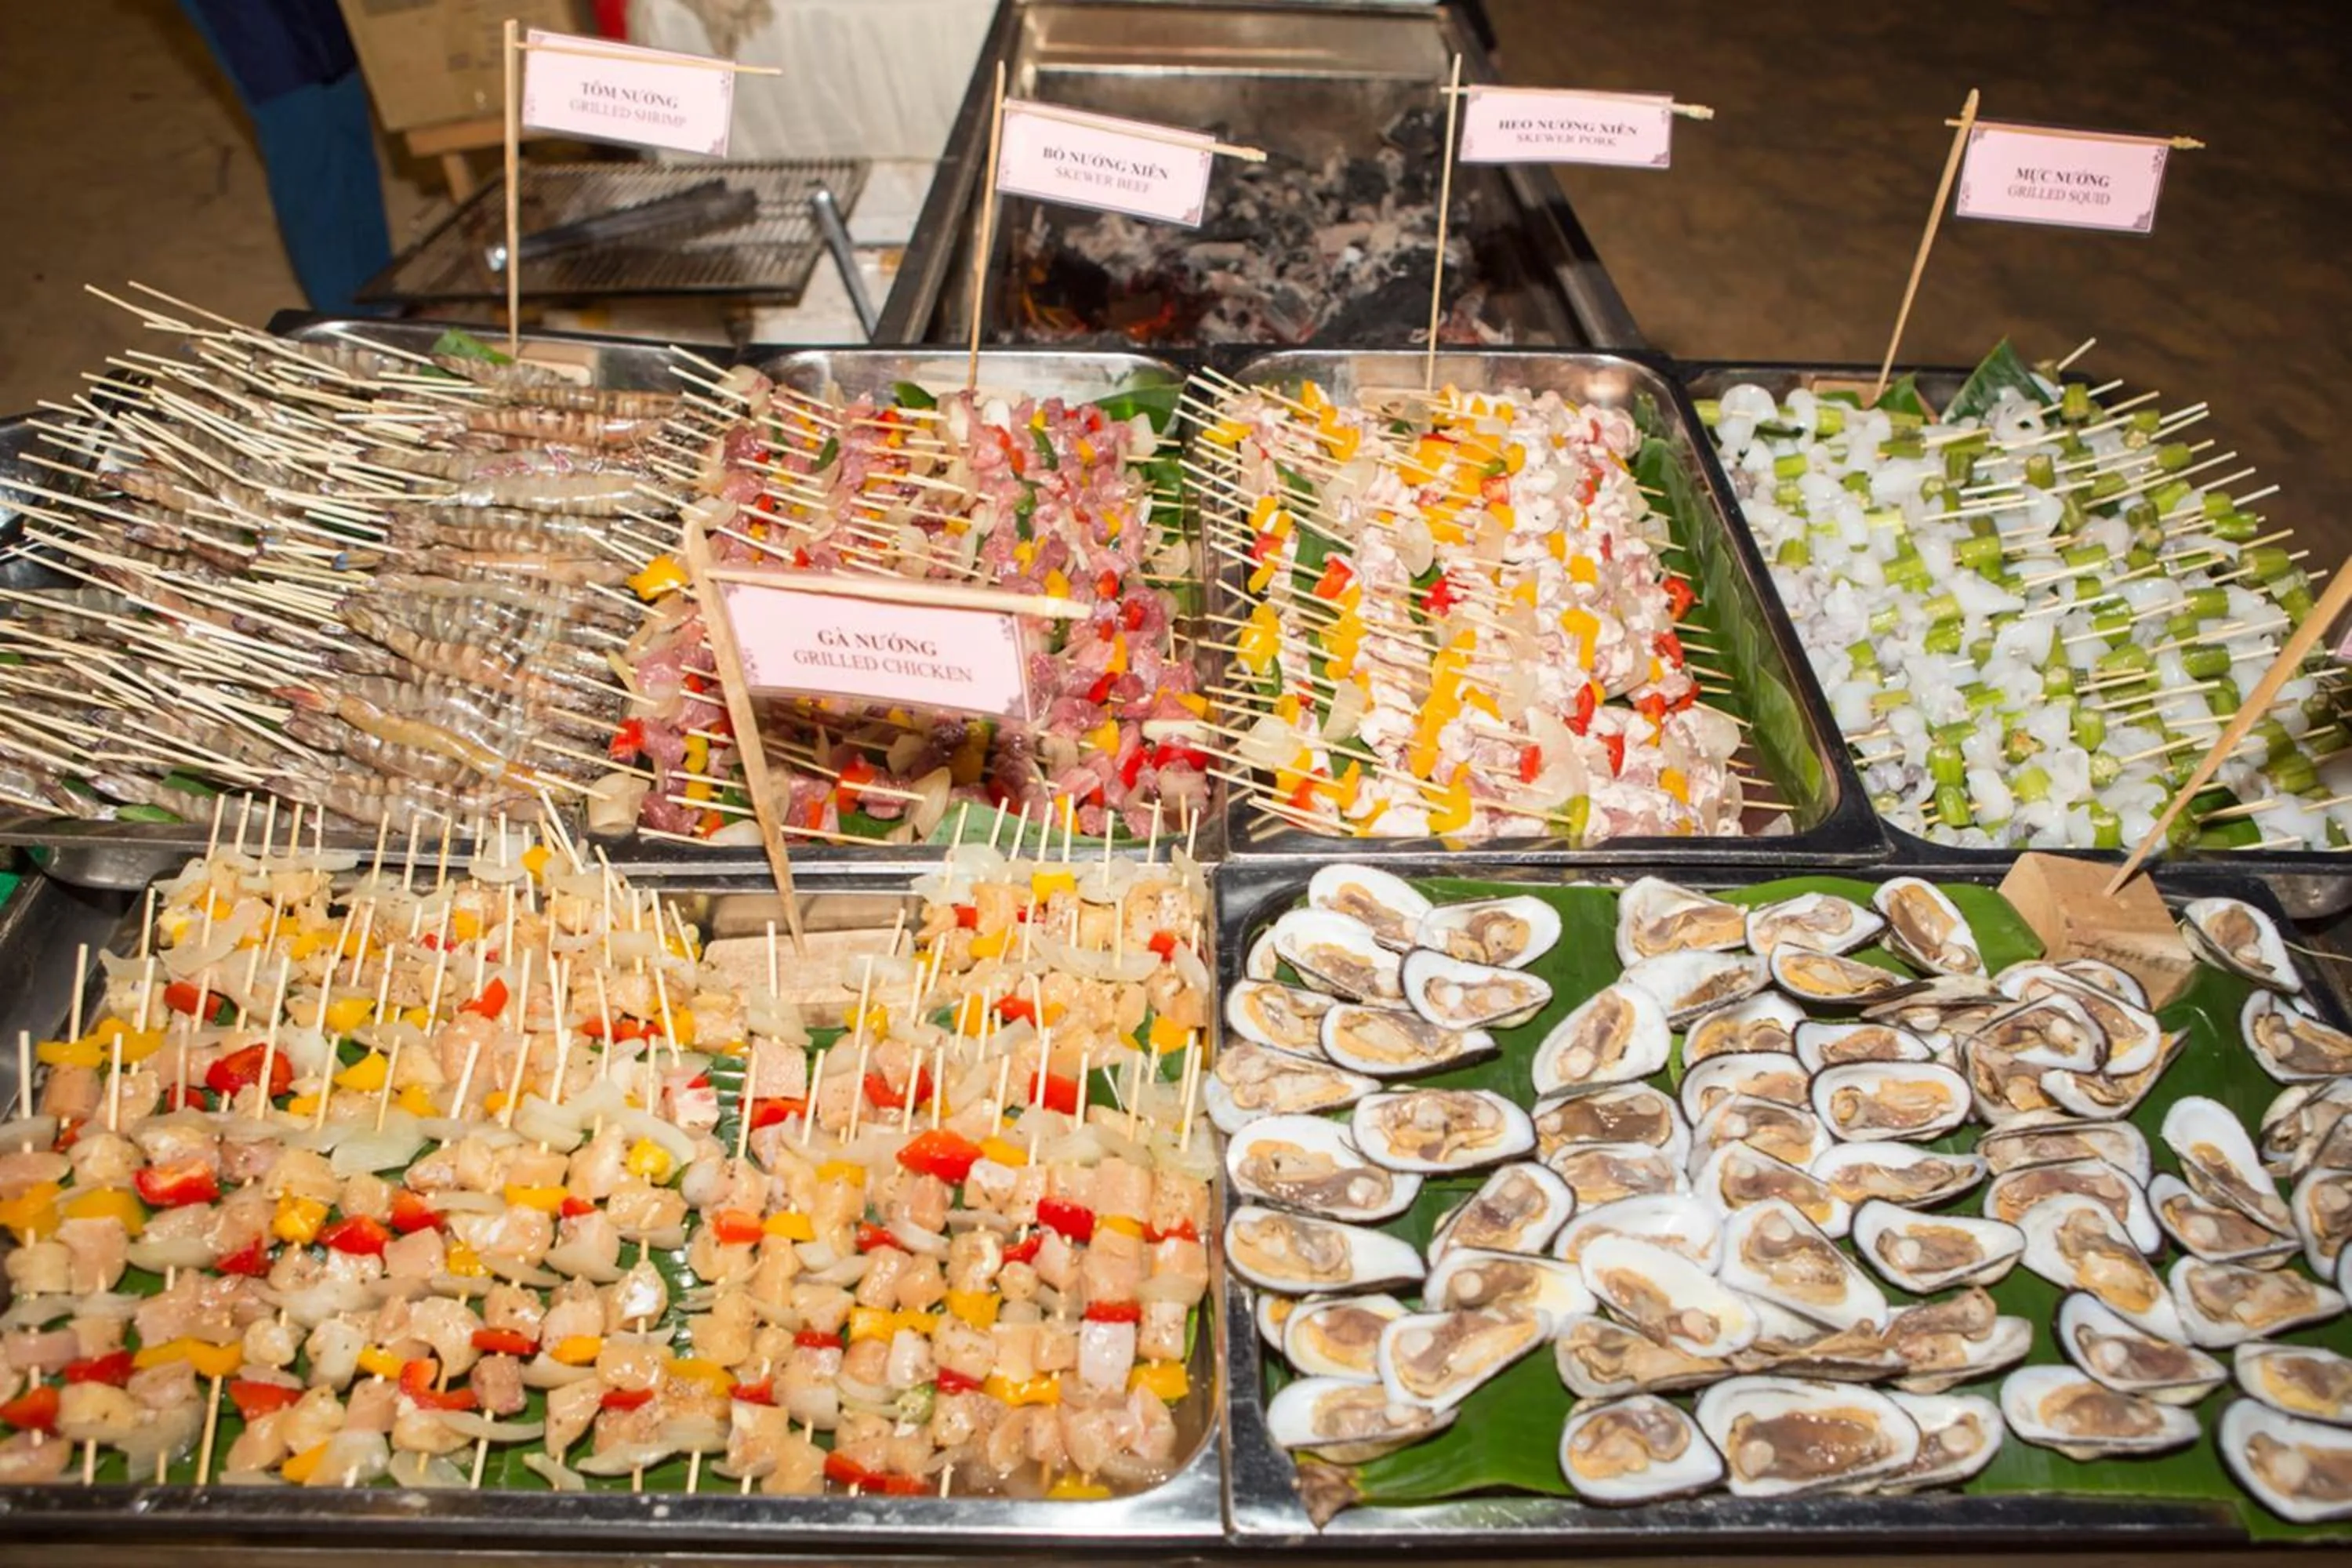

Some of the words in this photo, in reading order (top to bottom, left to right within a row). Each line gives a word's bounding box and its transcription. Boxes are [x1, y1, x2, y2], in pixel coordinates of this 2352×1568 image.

[569, 99, 631, 118] GRILLED
[634, 108, 687, 128] SHRIMP
[1498, 119, 1533, 130] HEO
[1516, 133, 1574, 144] SKEWER
[1580, 135, 1617, 147] PORK
[1054, 166, 1112, 187] SKEWER
[1117, 177, 1151, 194] BEEF
[2007, 184, 2066, 201] GRILLED
[2068, 191, 2111, 205] SQUID
[855, 633, 938, 657] NƯỚNG
[793, 649, 878, 672] GRILLED
[883, 659, 973, 683] CHICKEN
